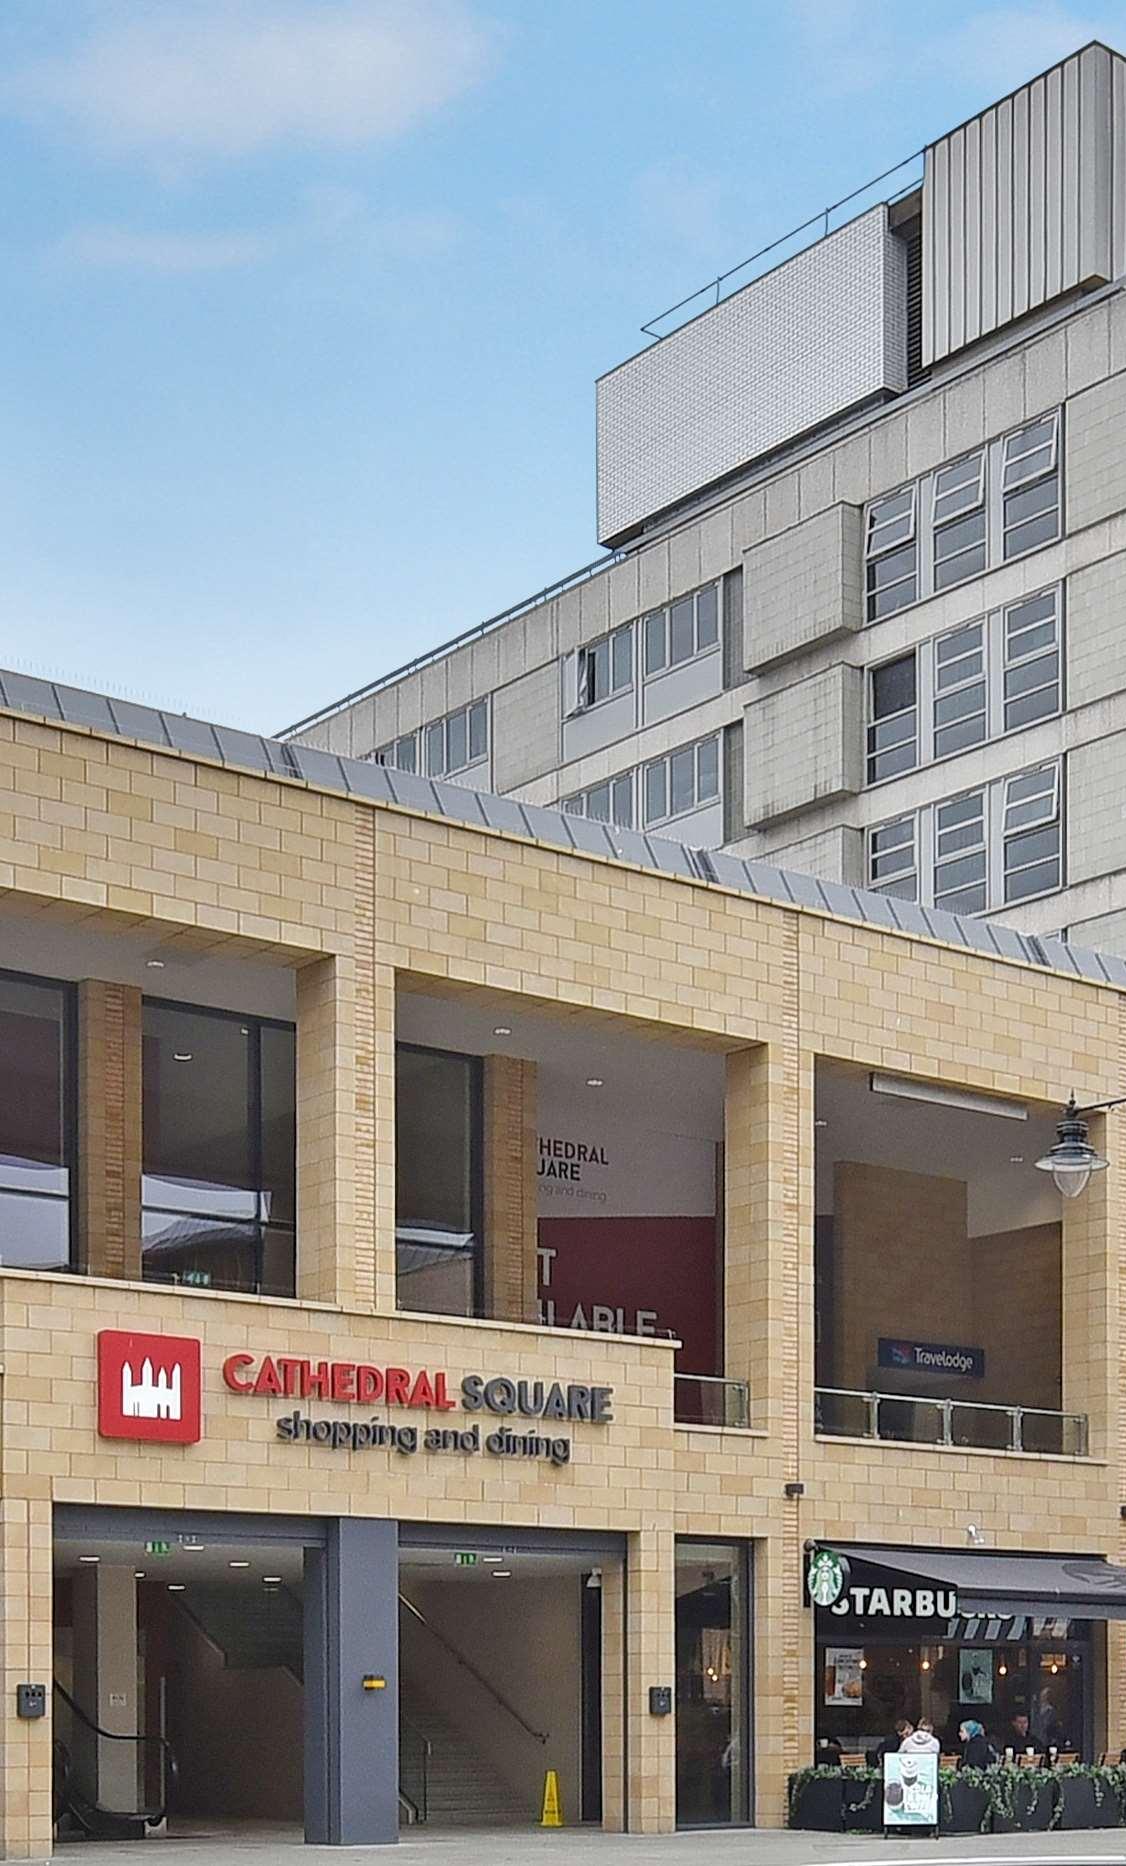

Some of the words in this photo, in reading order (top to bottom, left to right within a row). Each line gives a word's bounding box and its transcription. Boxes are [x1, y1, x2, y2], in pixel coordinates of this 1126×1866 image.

[538, 1137, 609, 1166] HEDRAL
[536, 1158, 581, 1181] UARE
[914, 1347, 974, 1373] Travelodge
[222, 1353, 456, 1411] CATHEDRAL
[460, 1374, 614, 1424] SQUARE
[276, 1411, 418, 1455] shopping
[424, 1424, 480, 1455] and
[485, 1427, 571, 1466] dining
